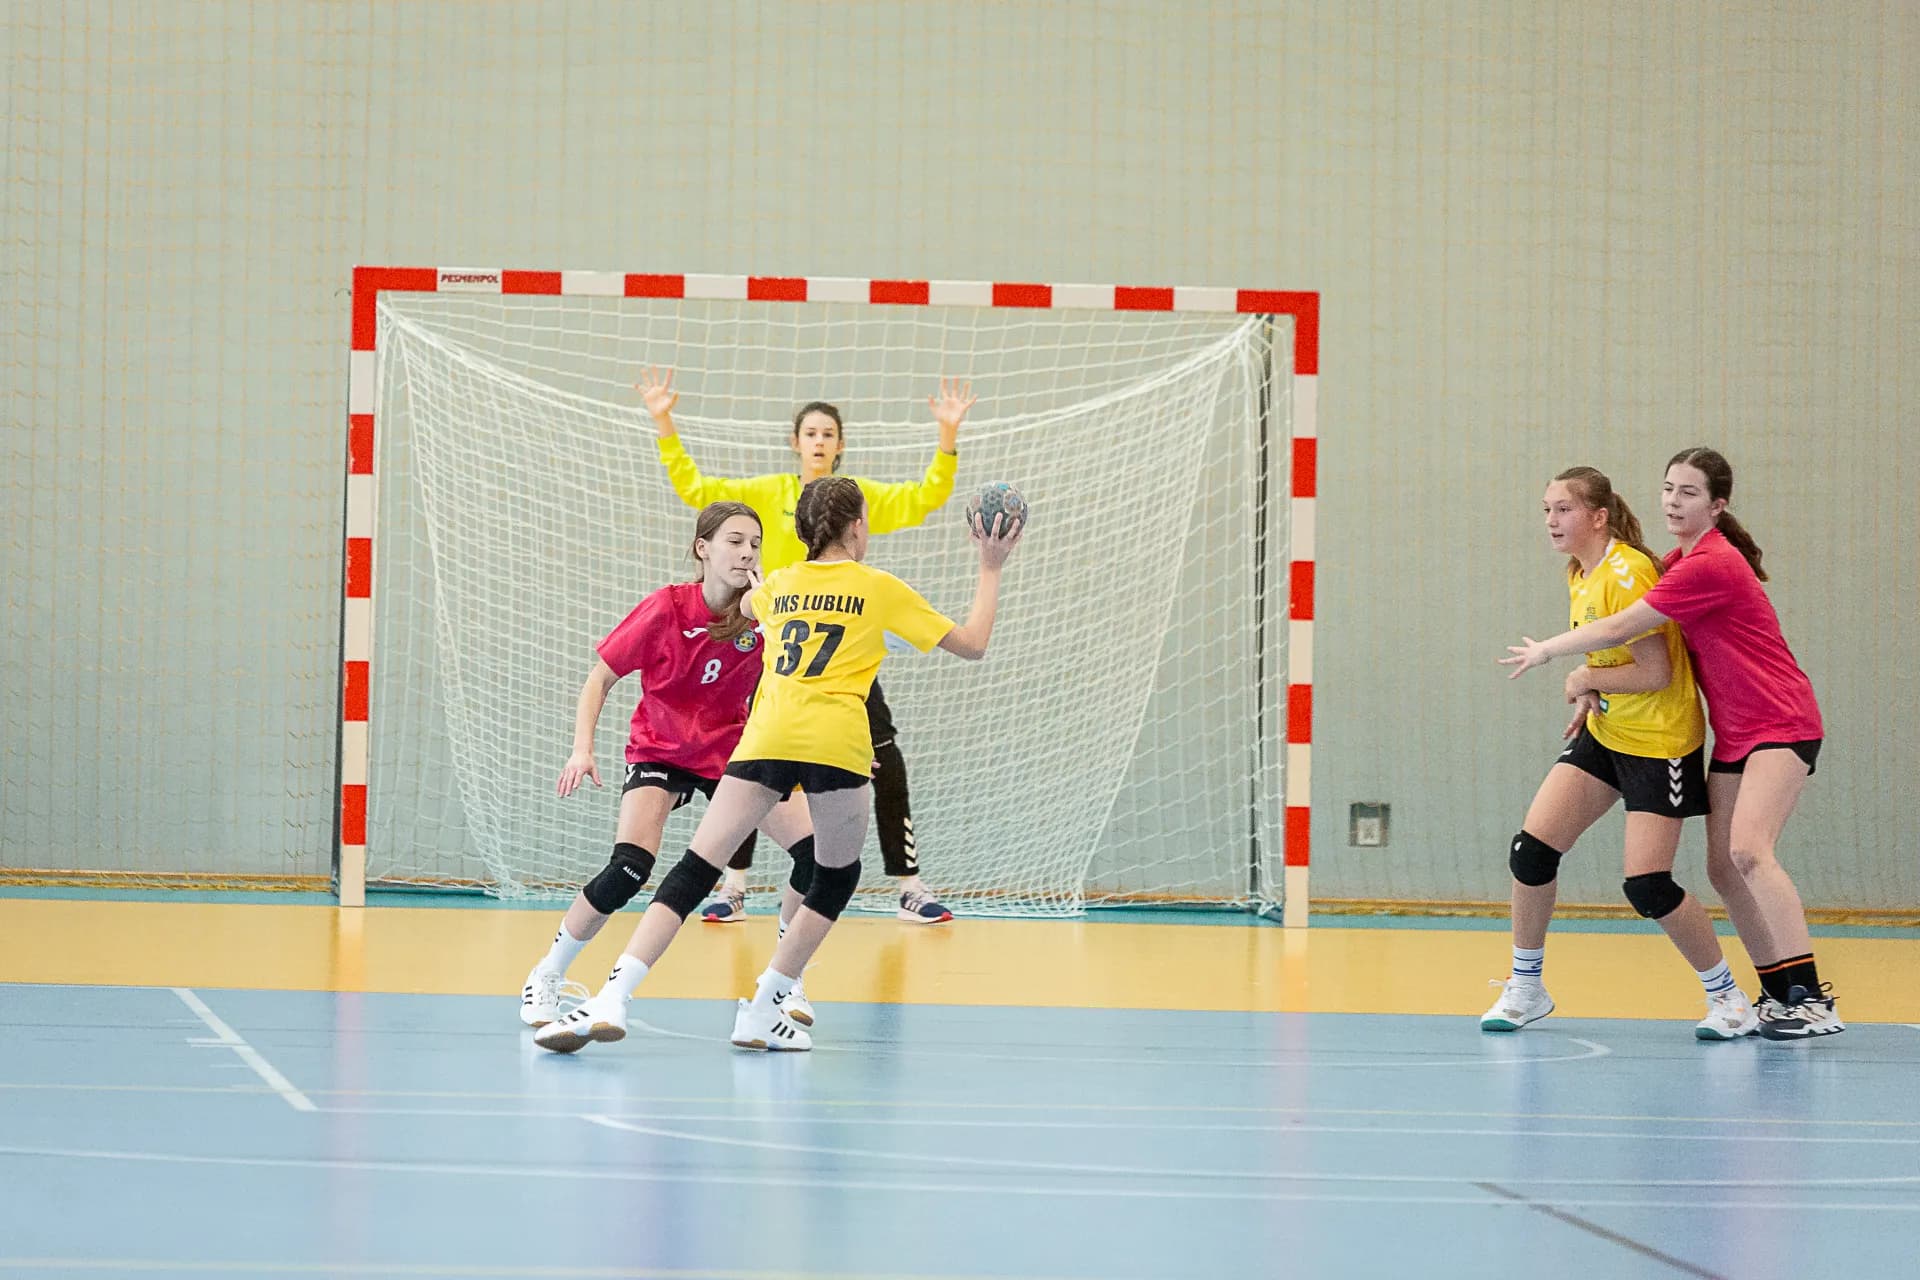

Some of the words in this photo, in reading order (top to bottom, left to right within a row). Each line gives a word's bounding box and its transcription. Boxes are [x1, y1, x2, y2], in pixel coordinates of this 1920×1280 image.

[802, 595, 865, 616] LUBLIN
[775, 619, 846, 678] 37
[701, 658, 723, 685] 8
